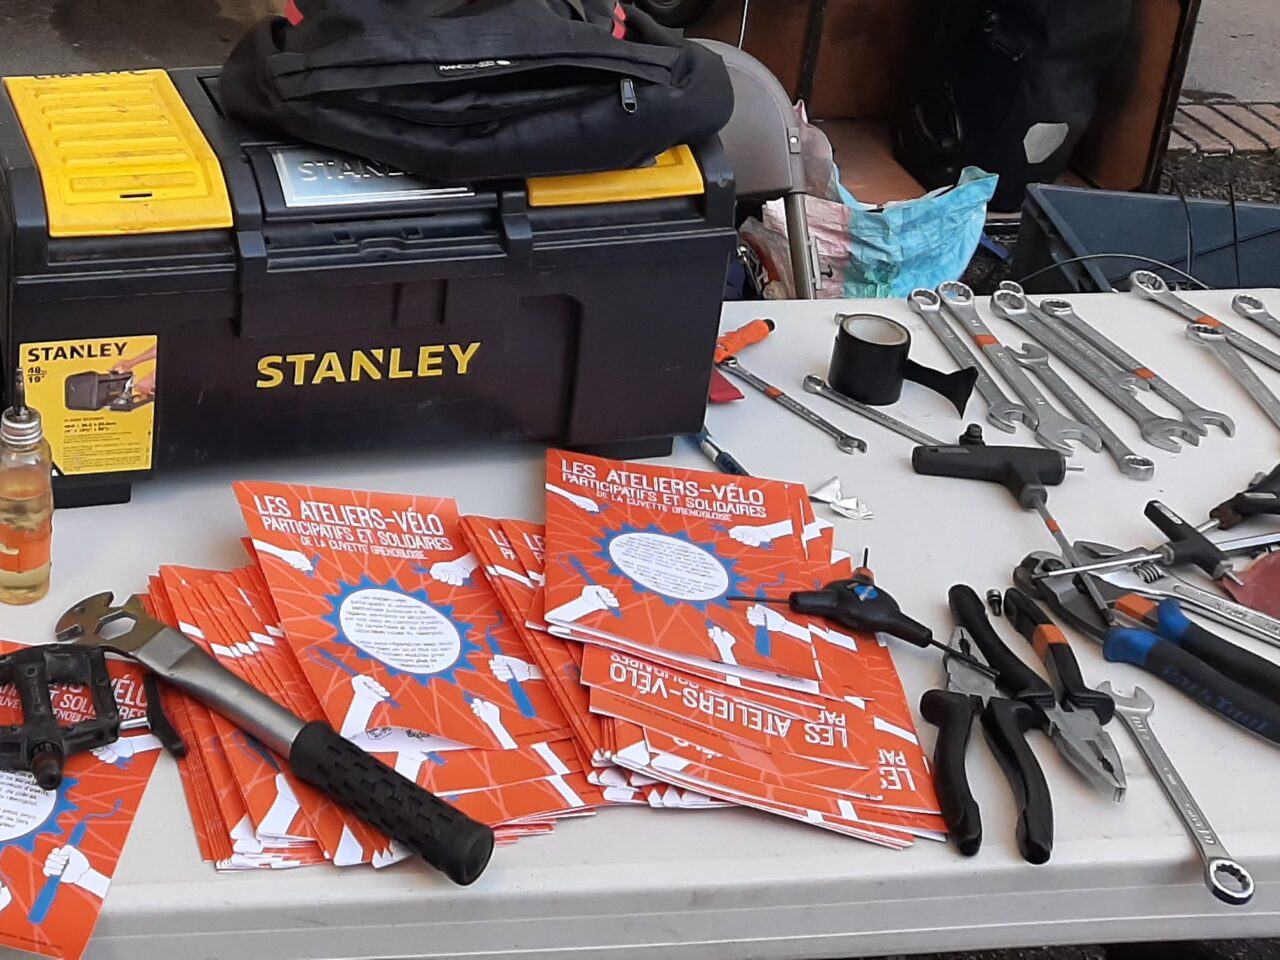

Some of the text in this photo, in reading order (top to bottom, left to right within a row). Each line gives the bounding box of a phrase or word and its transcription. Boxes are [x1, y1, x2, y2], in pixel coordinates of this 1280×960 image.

[27, 341, 128, 363] STANLEY
[256, 342, 482, 389] STANLEY
[561, 458, 765, 506] LES ATELIERS-VÉLO
[562, 472, 768, 519] PARTICIPATIFS ET SOLIDAIRES
[253, 494, 445, 536] LES ATELIERS-VÉLO
[261, 515, 454, 551] PARTICIPATIFS ET SOLIDAIRES
[609, 662, 848, 749] LES ATELIERS-VÉLO
